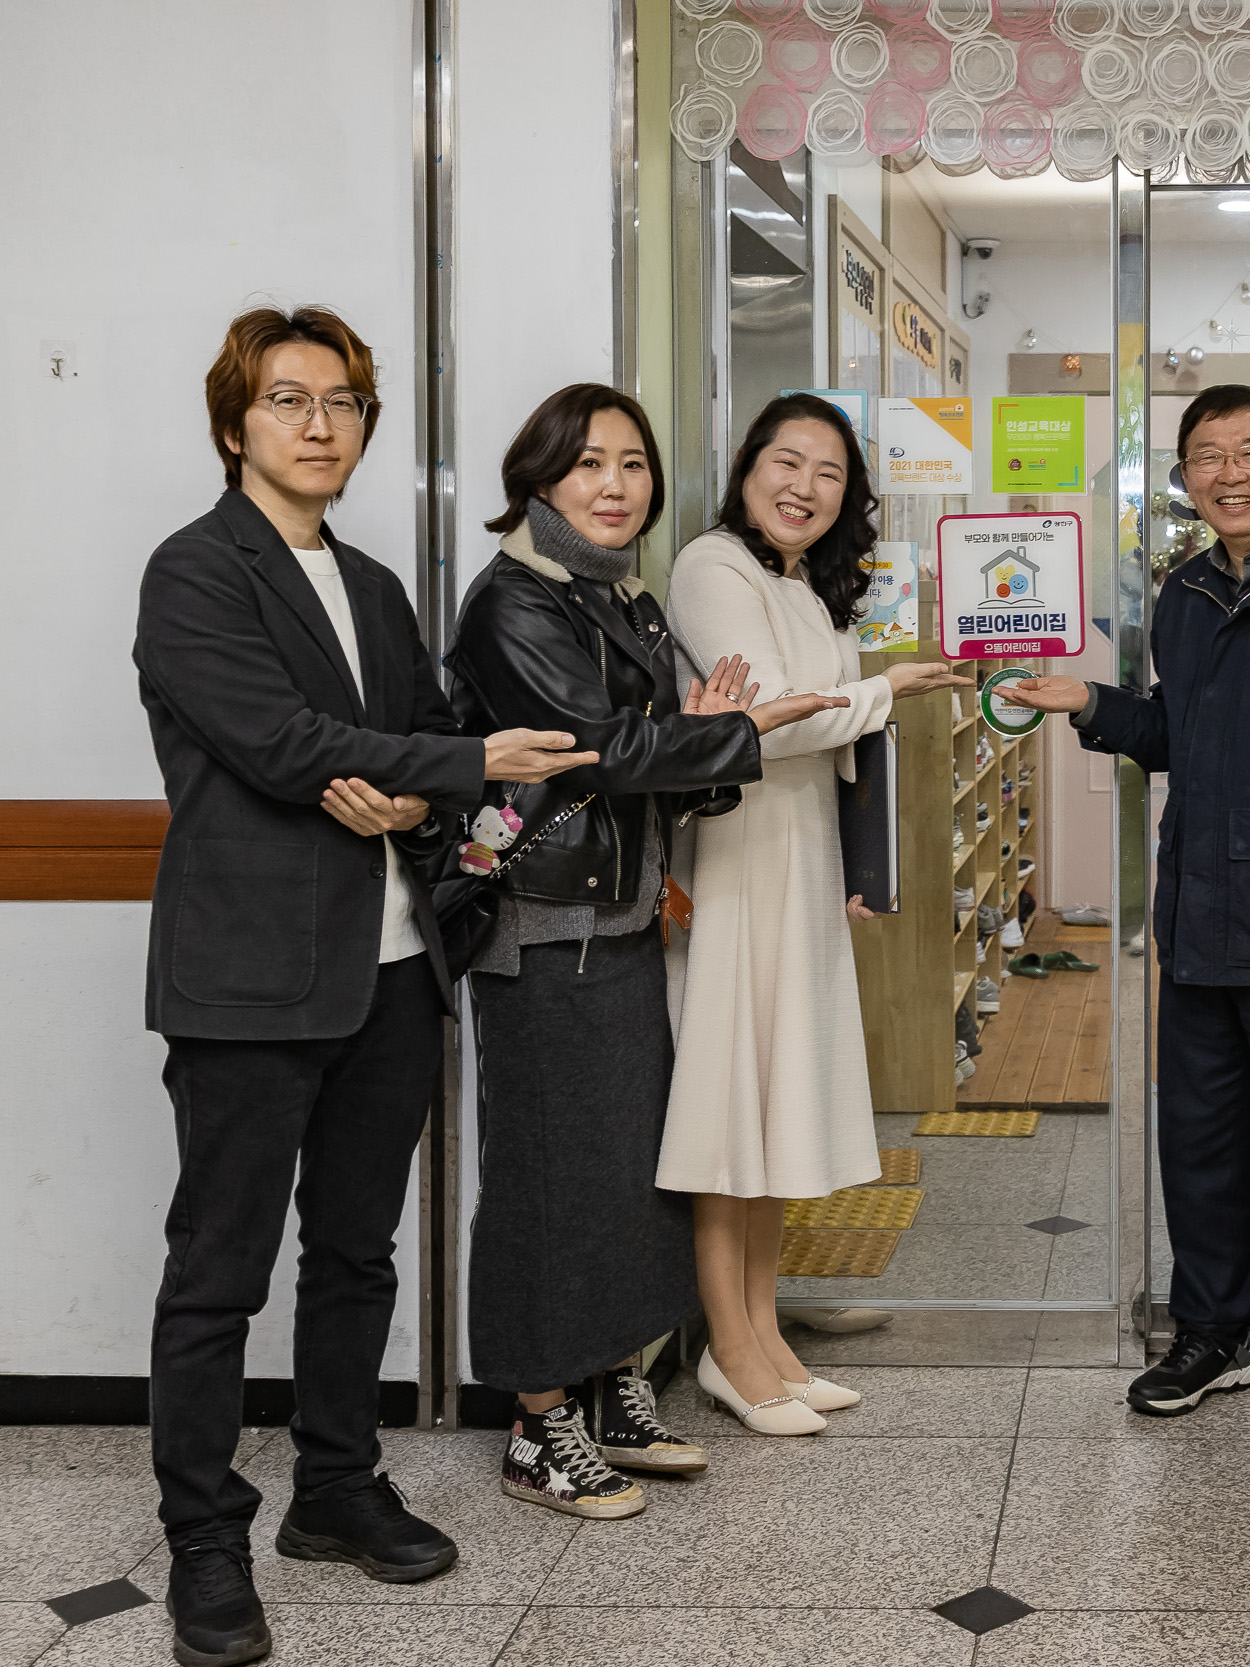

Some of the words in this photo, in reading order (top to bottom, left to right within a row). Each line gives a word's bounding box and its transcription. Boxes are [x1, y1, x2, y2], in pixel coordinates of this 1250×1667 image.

[1006, 420, 1071, 432] 인성교육대상
[889, 460, 912, 471] 2021
[914, 459, 953, 471] 대한민국
[889, 473, 928, 484] 교육브랜드
[929, 473, 945, 483] 대상
[946, 472, 963, 483] 수상
[964, 534, 990, 544] 부모와
[992, 533, 1010, 543] 함께
[1011, 532, 1055, 543] 만들어가는
[878, 575, 895, 586] 이용
[957, 613, 1066, 635] 열린어린이집
